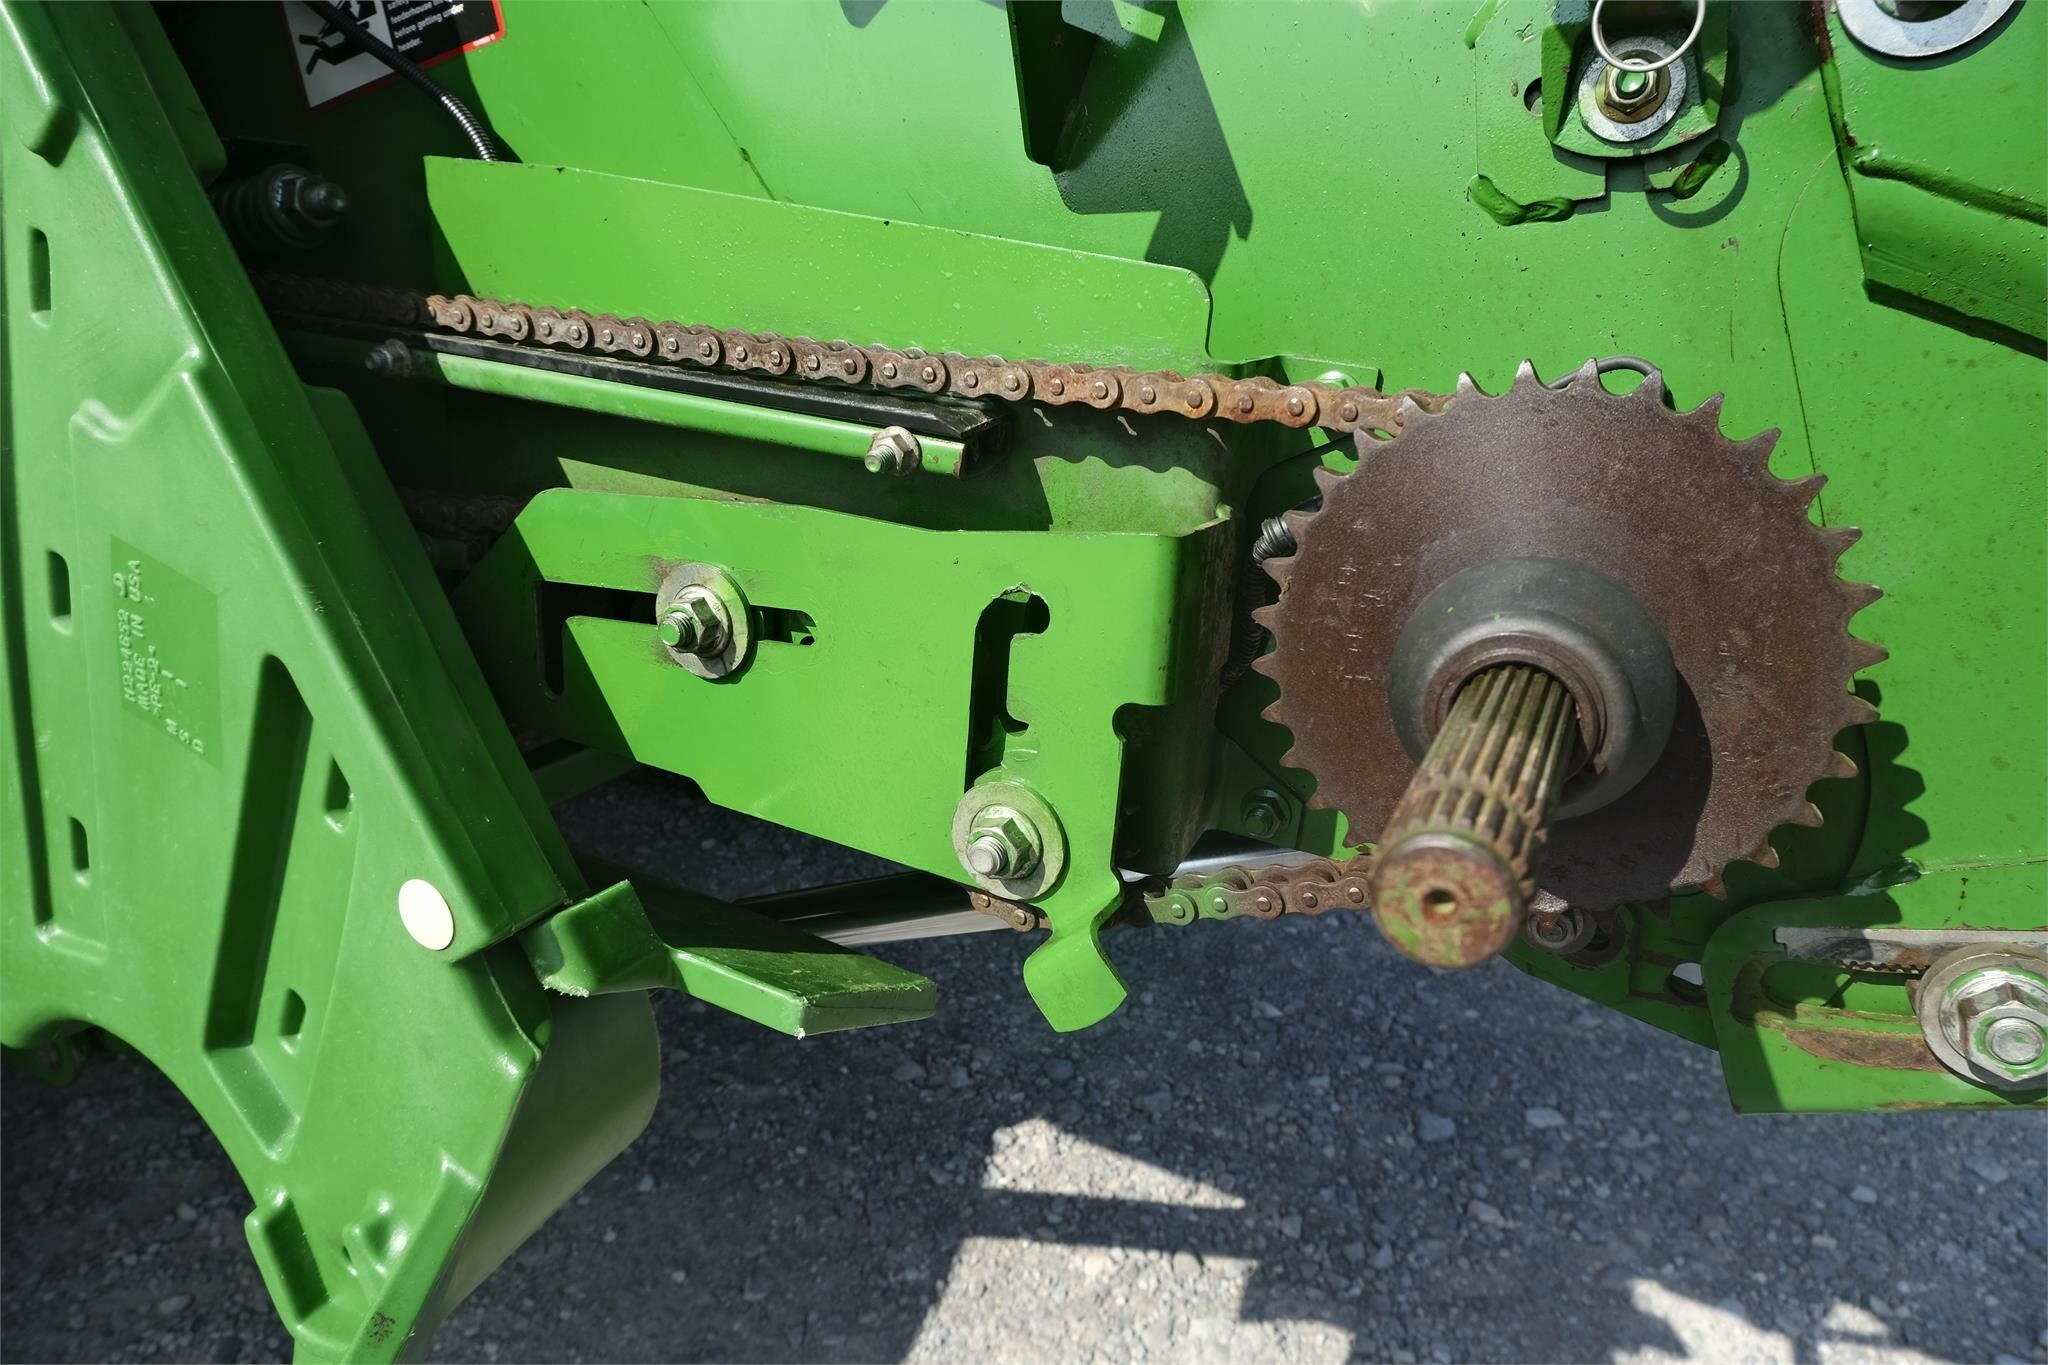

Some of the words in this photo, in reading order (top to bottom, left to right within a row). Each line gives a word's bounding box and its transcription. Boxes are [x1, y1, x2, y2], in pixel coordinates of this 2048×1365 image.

[394, 24, 417, 39] before
[417, 13, 443, 31] getting
[443, 3, 465, 18] under
[127, 559, 141, 603] USA
[130, 613, 144, 638] IN
[133, 653, 150, 711] MADE
[165, 718, 178, 736] M
